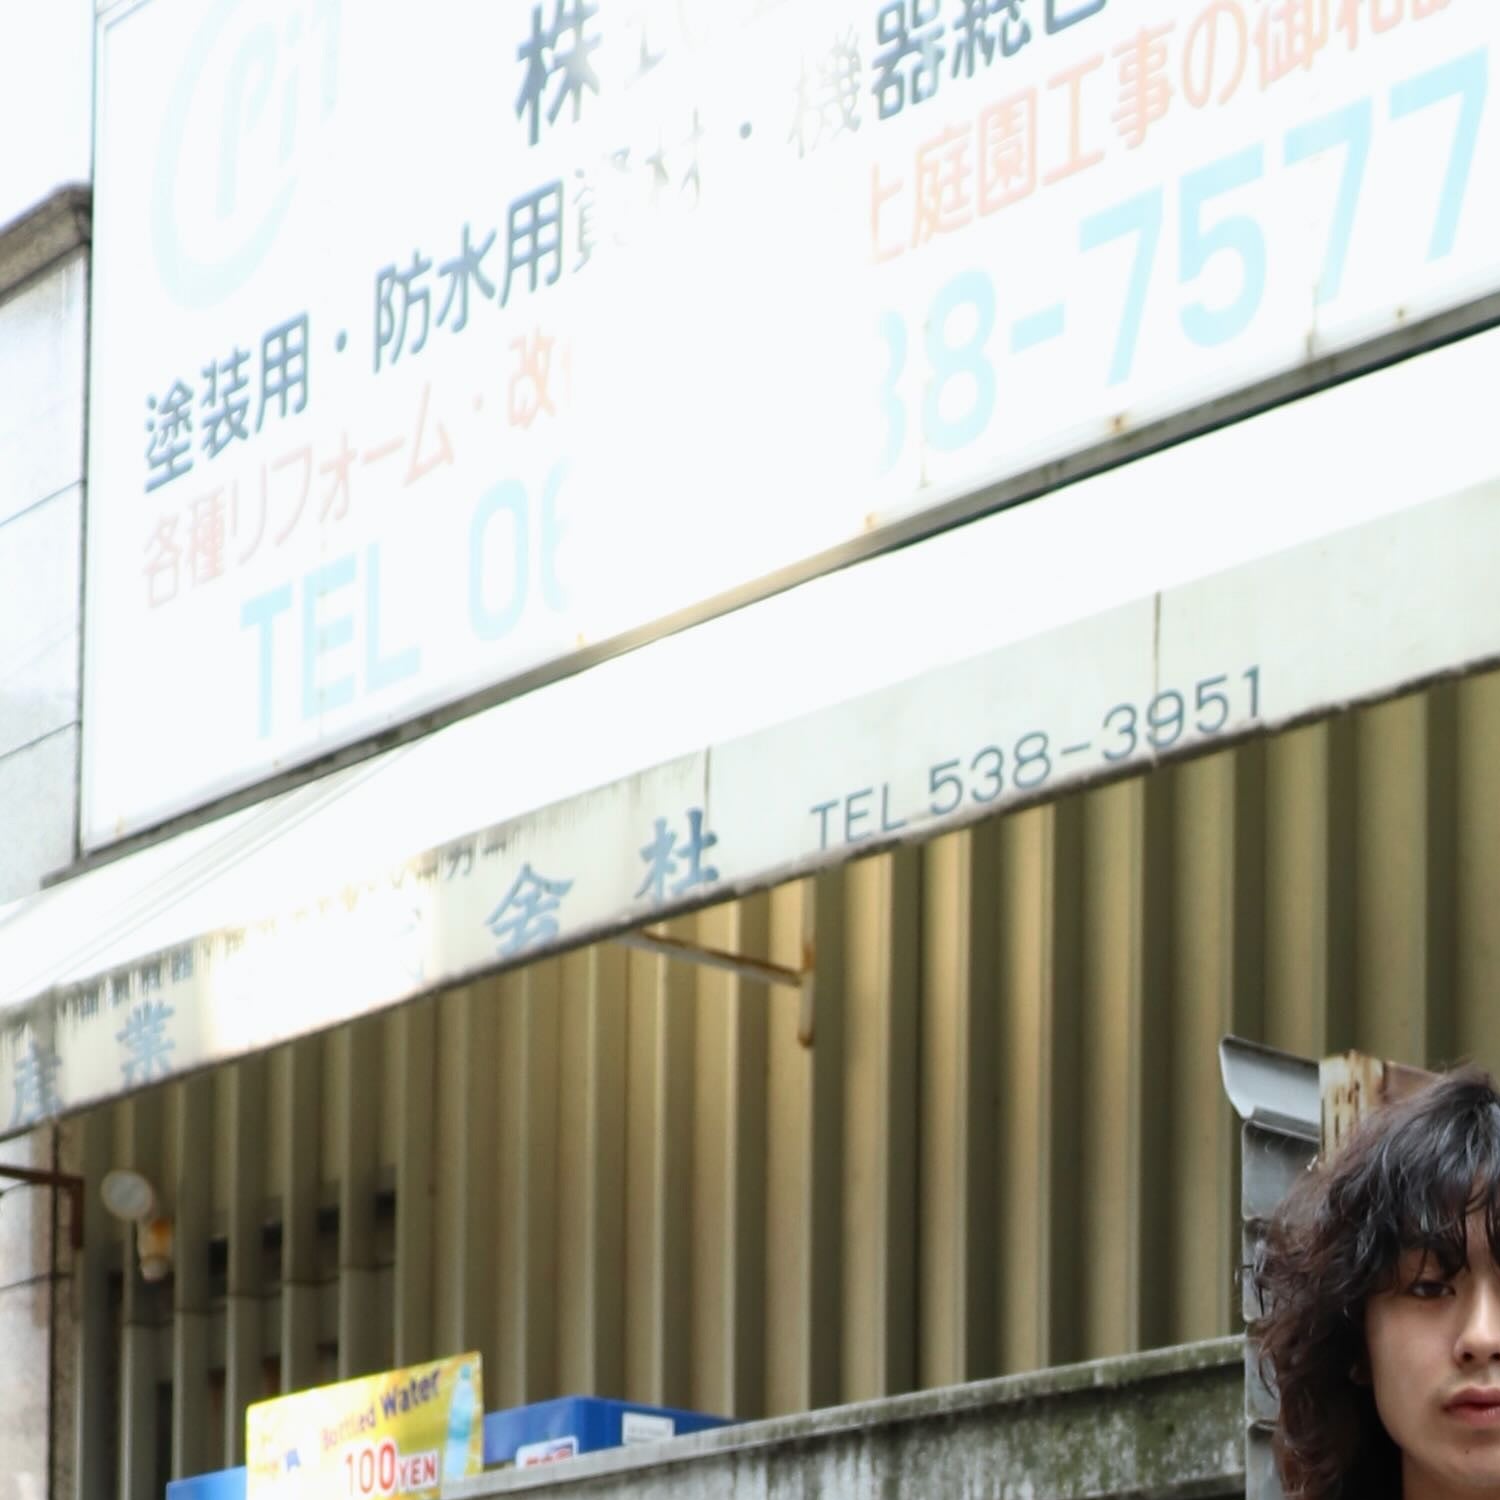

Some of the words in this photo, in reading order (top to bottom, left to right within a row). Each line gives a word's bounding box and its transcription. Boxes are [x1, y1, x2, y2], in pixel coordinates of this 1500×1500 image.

[239, 539, 423, 741] TEL
[809, 781, 908, 852] TEL
[927, 663, 1262, 817] 538-3951
[380, 1367, 440, 1418] Water
